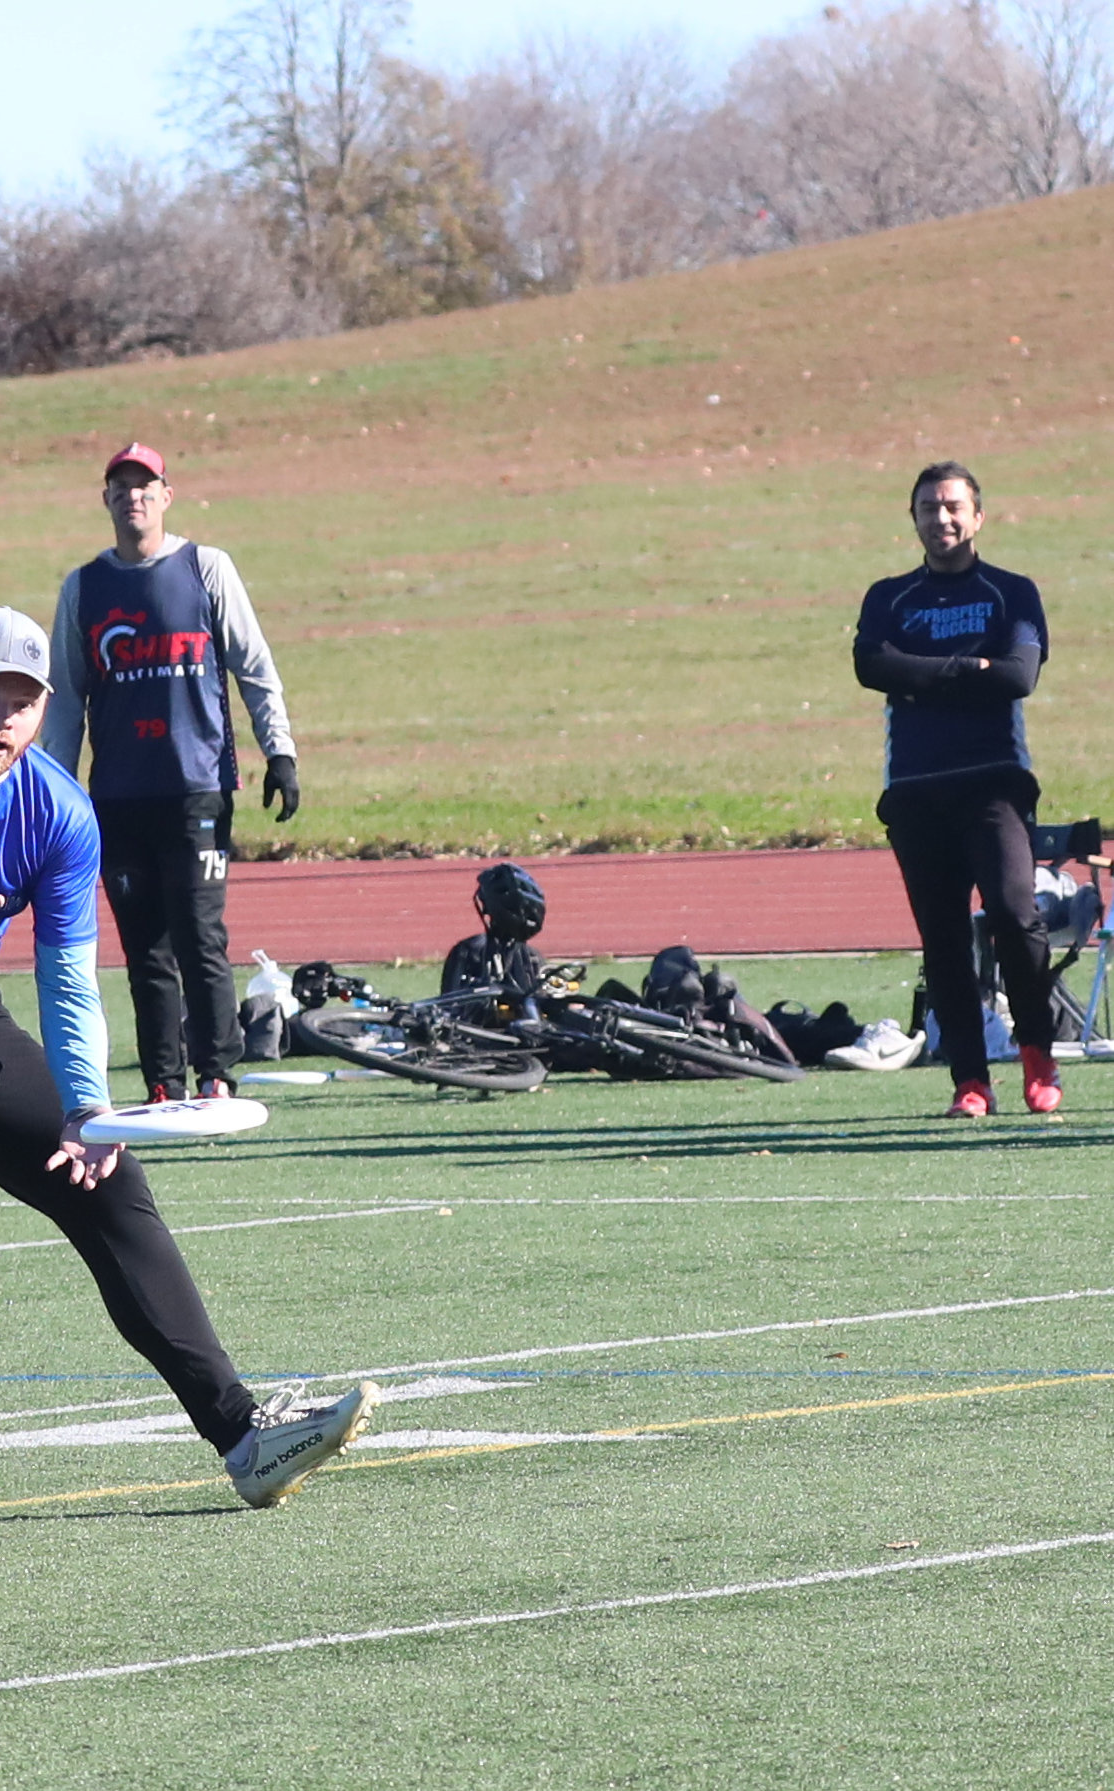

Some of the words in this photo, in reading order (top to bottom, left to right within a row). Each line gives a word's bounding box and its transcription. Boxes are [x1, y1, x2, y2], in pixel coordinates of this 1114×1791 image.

[923, 602, 994, 623] PROSPECT
[931, 617, 985, 639] SOCCER
[114, 631, 210, 664] SHIFT
[134, 718, 168, 739] 79
[198, 849, 227, 881] 79
[253, 1458, 278, 1480] new
[278, 1431, 324, 1464] balance
